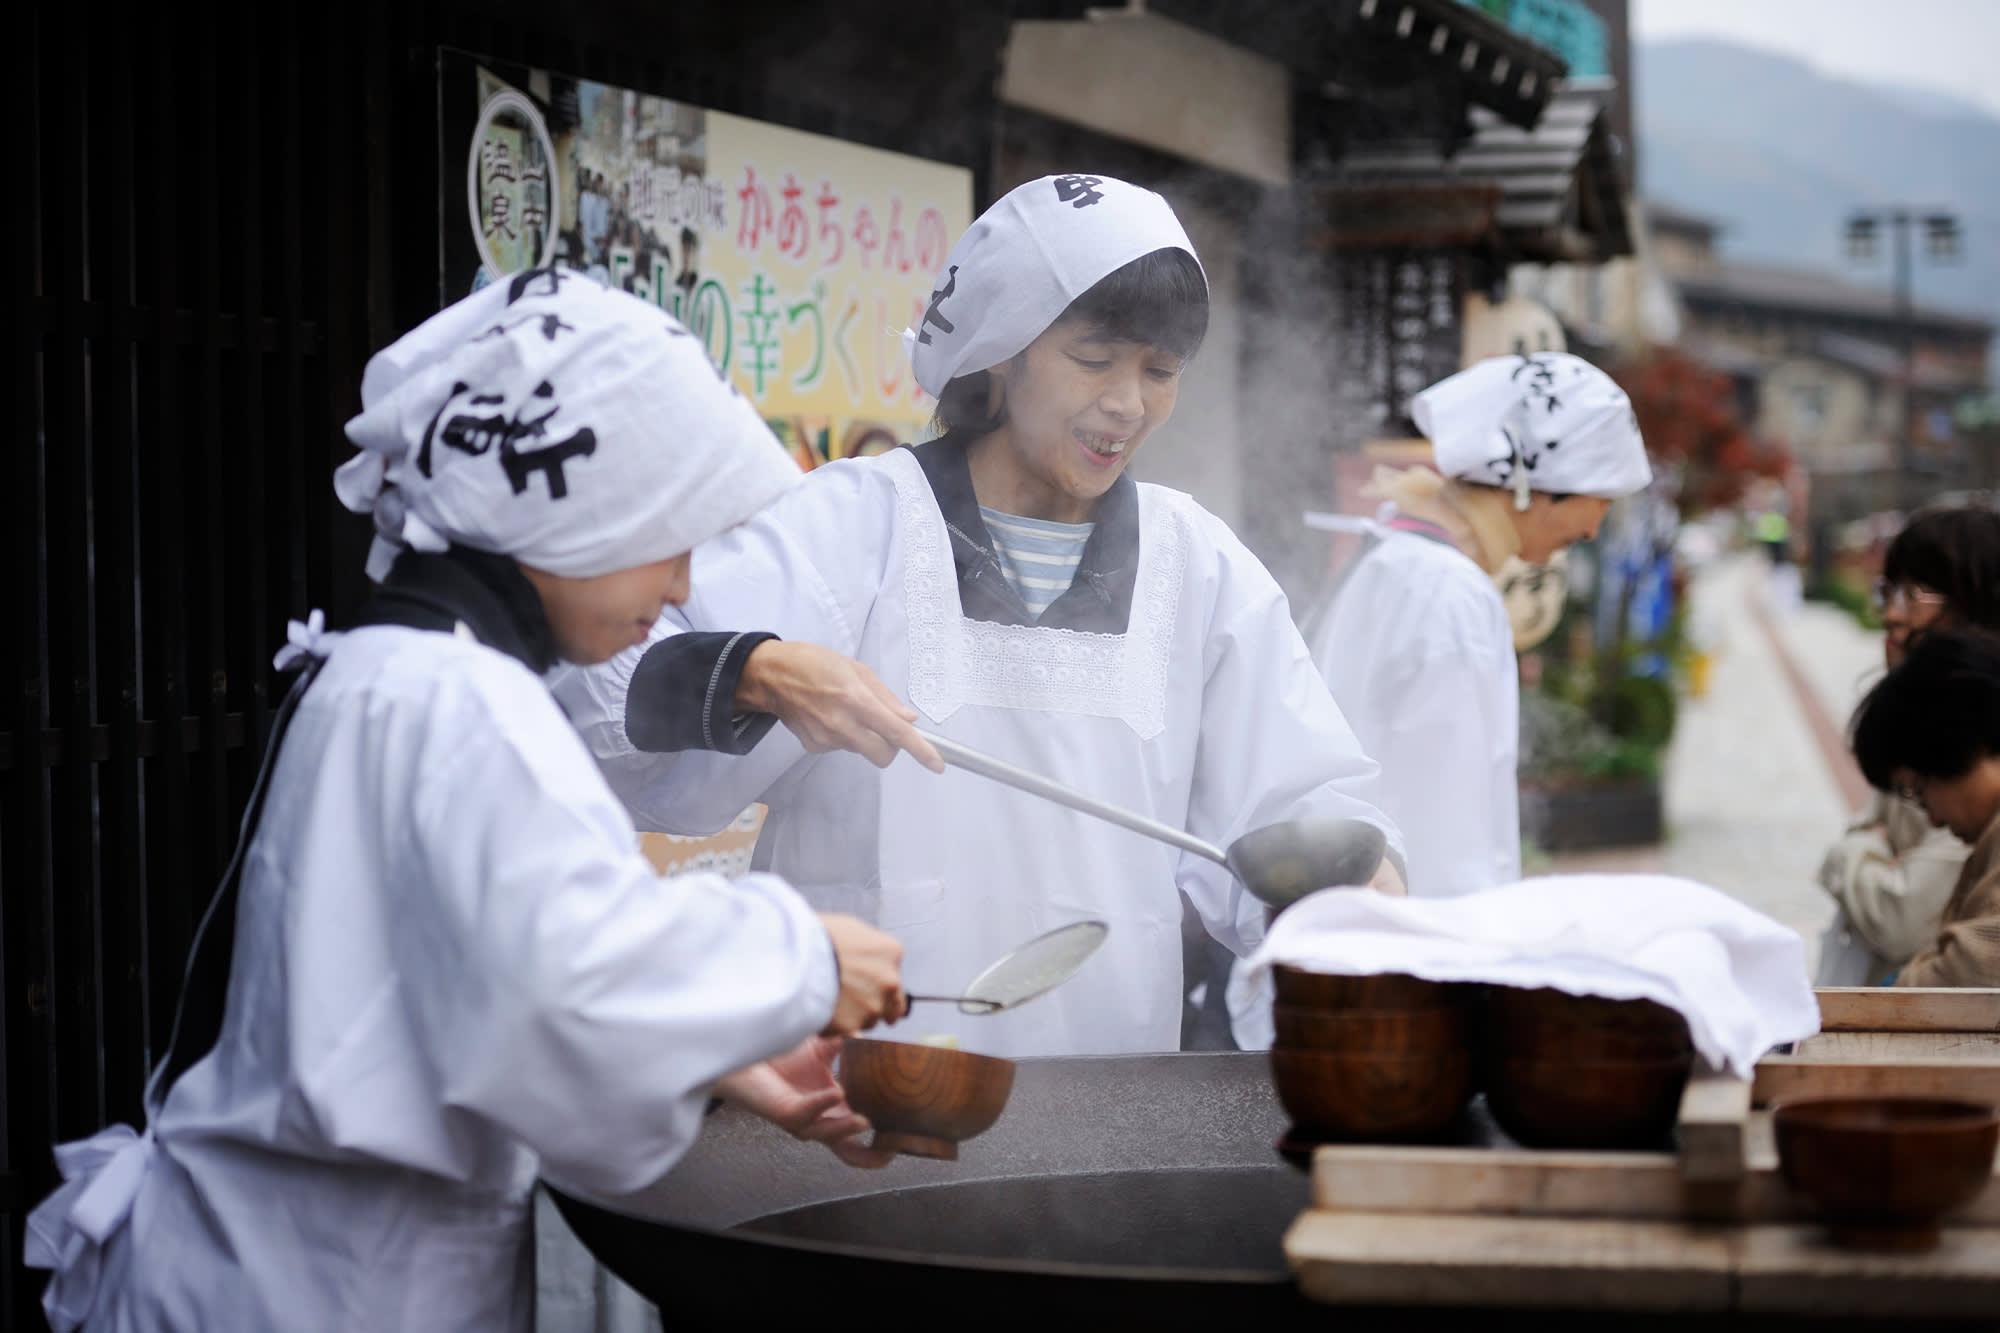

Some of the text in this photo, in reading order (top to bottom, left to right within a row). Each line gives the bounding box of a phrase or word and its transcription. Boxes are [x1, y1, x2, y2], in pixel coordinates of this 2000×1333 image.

[736, 164, 949, 276] かあちゃんの
